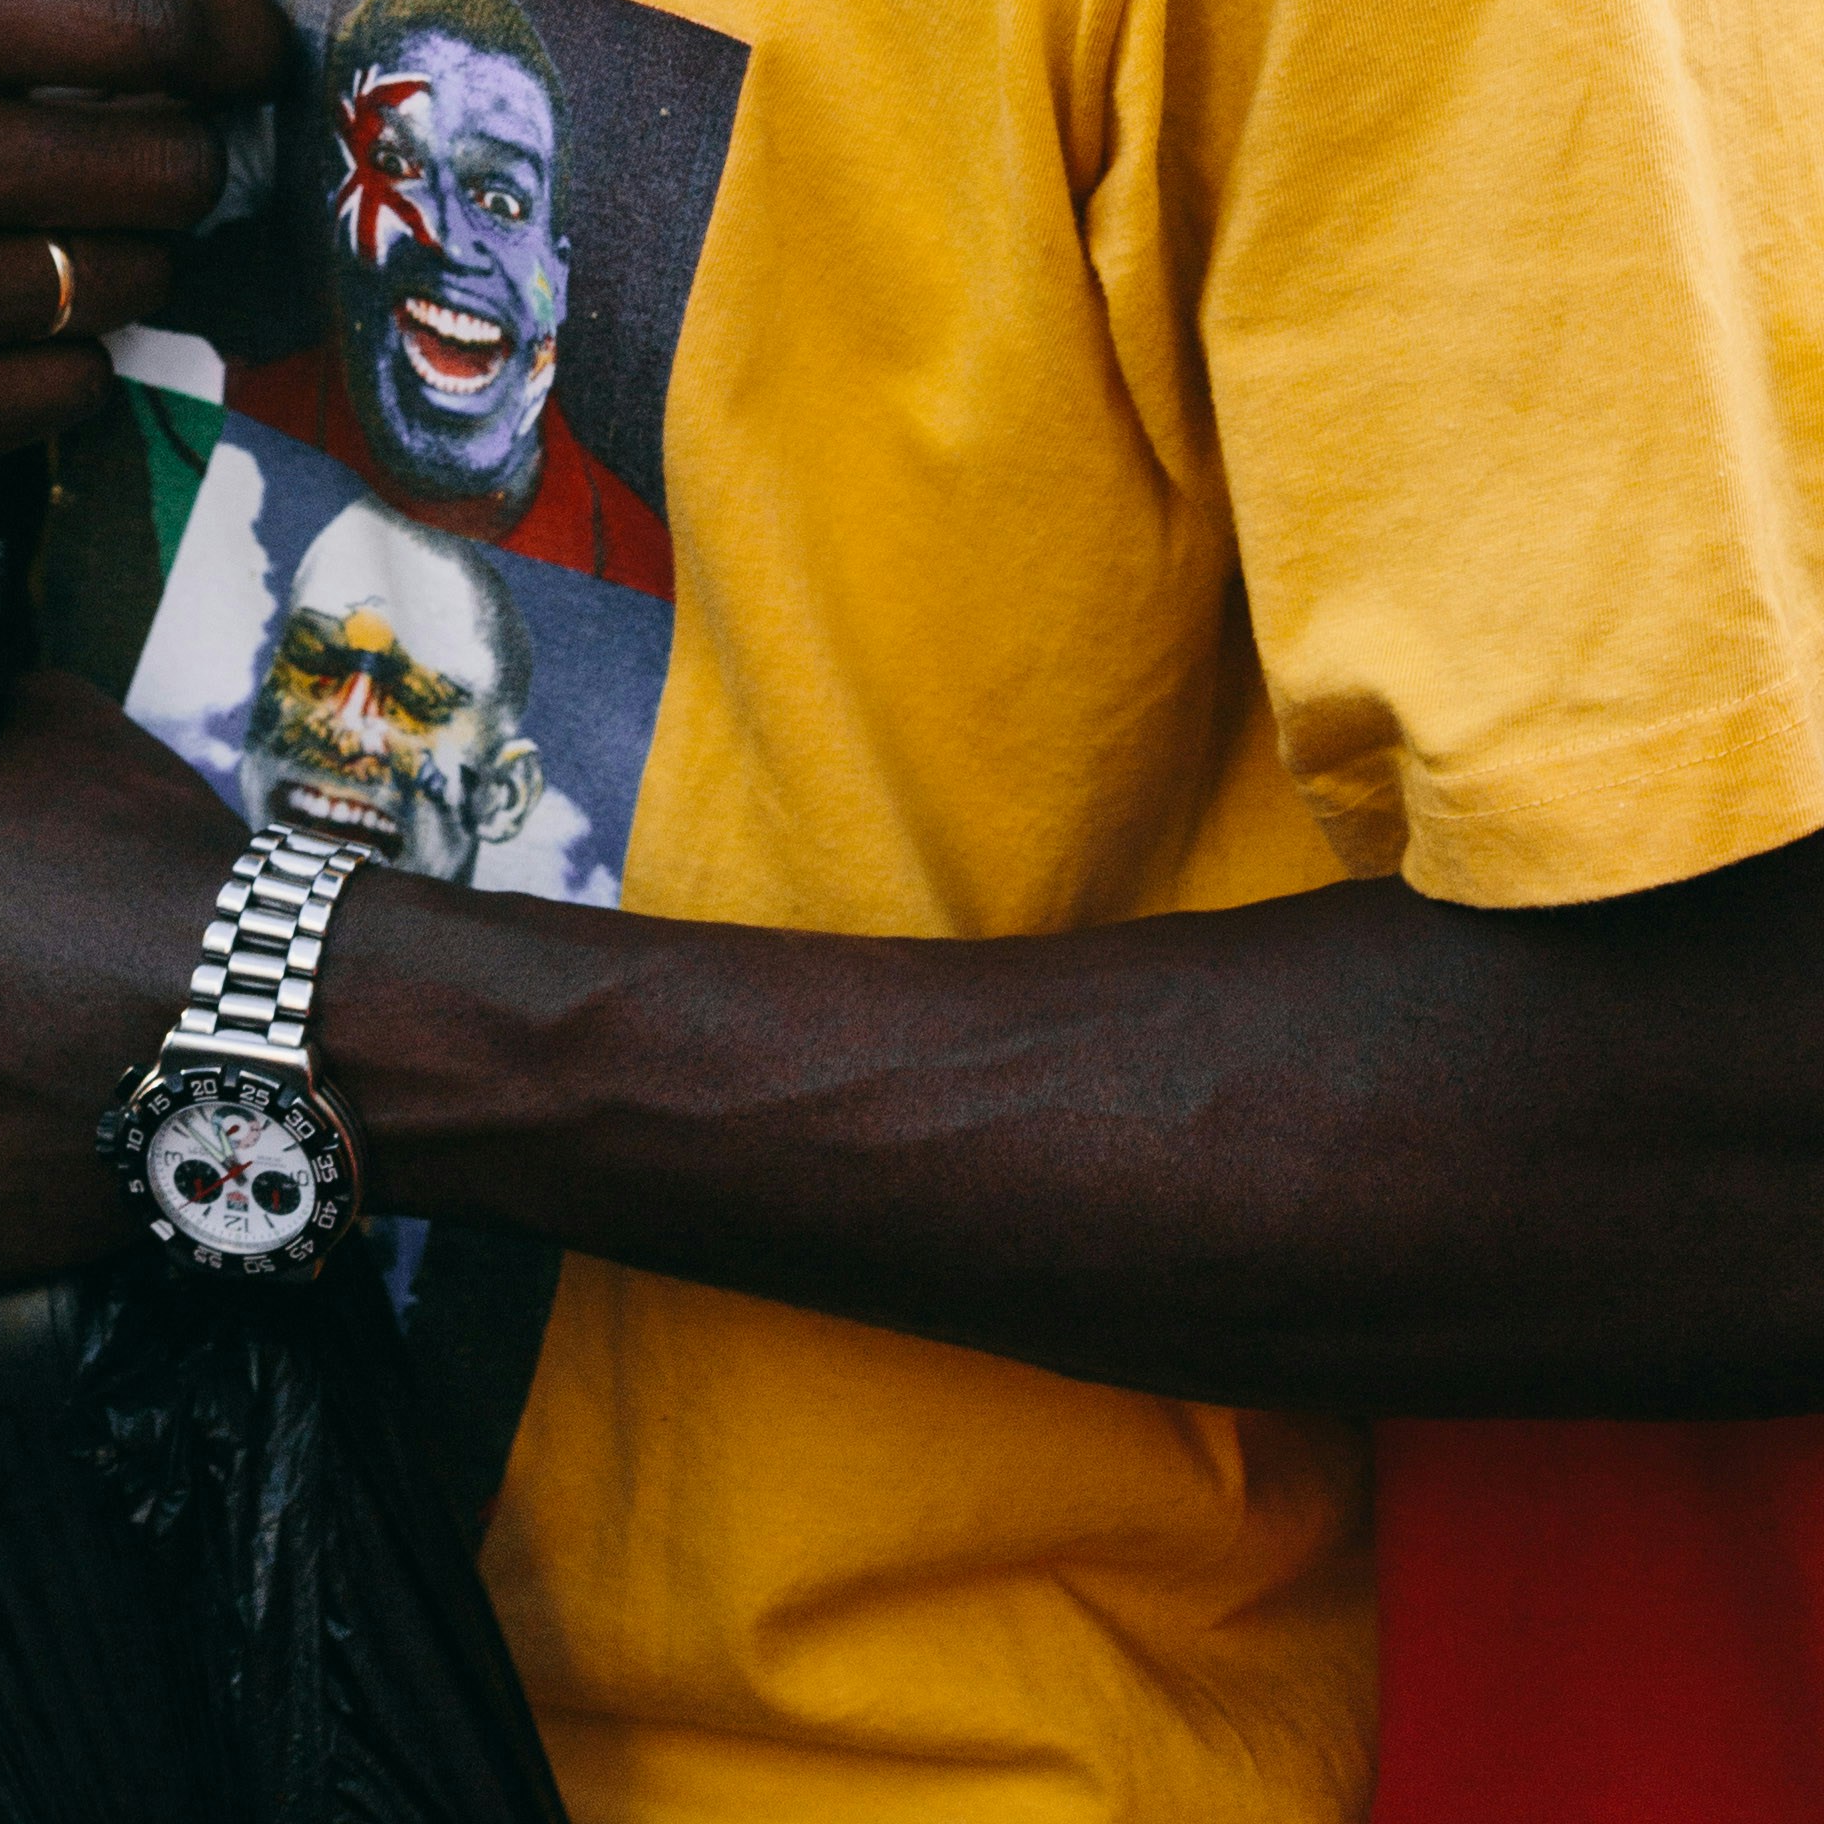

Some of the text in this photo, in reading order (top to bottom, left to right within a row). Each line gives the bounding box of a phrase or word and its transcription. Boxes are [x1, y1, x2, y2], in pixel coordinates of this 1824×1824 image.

[190, 1078, 219, 1097] 20
[239, 1083, 270, 1107] 25
[147, 1093, 171, 1116] 15
[285, 1108, 316, 1139] 30
[126, 1127, 144, 1152] 10
[316, 1154, 338, 1183] 35
[129, 1178, 145, 1194] 5
[317, 1201, 338, 1229] 40
[289, 1238, 314, 1261] 45
[242, 1257, 276, 1275] 50
